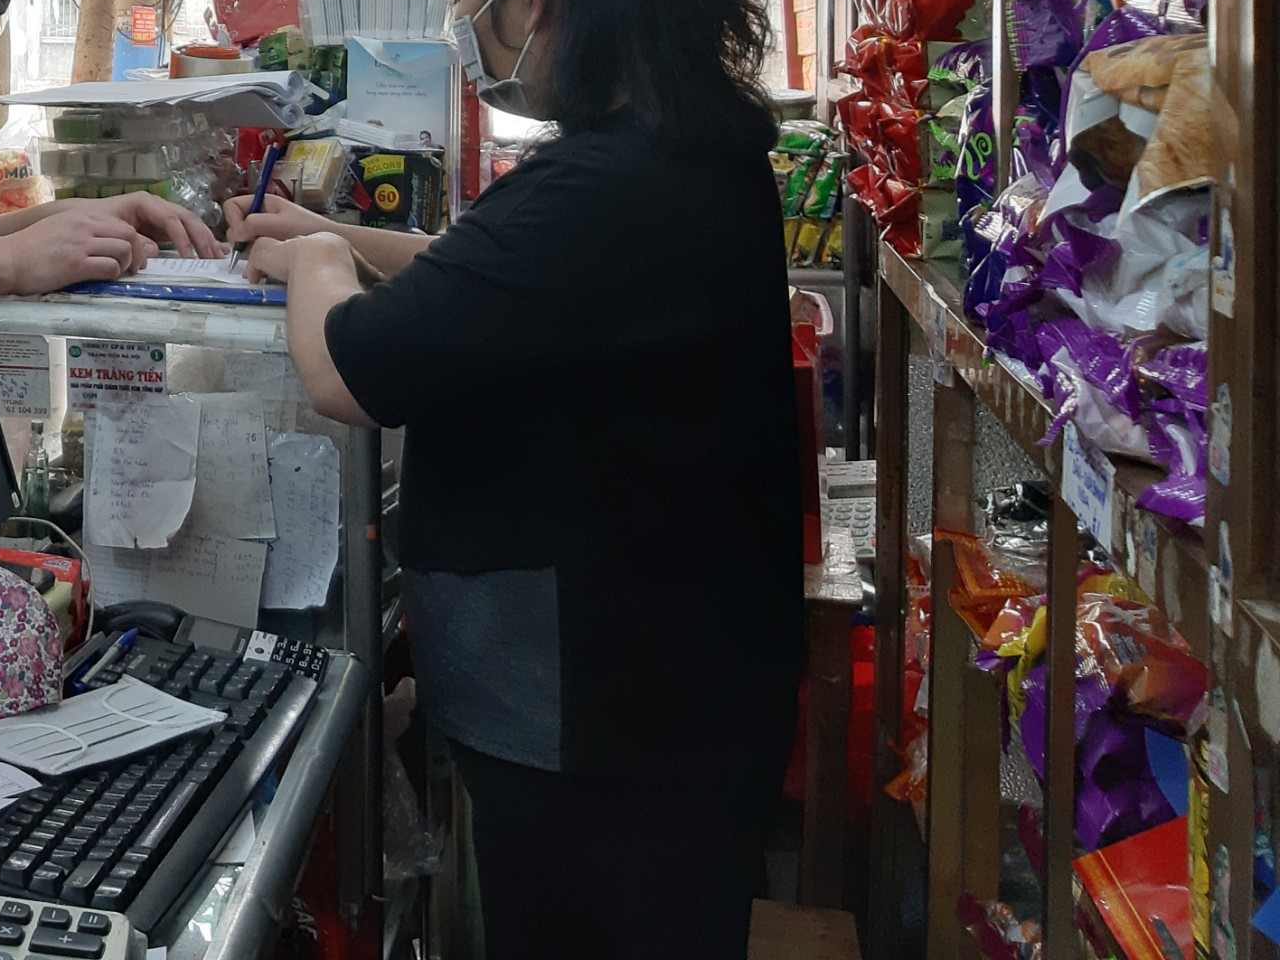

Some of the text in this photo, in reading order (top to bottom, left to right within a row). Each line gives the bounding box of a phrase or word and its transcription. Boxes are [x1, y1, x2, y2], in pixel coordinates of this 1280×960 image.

[367, 161, 402, 174] COLORS
[377, 190, 397, 203] 60
[70, 367, 93, 379] KEM
[136, 365, 163, 383] TIỀN
